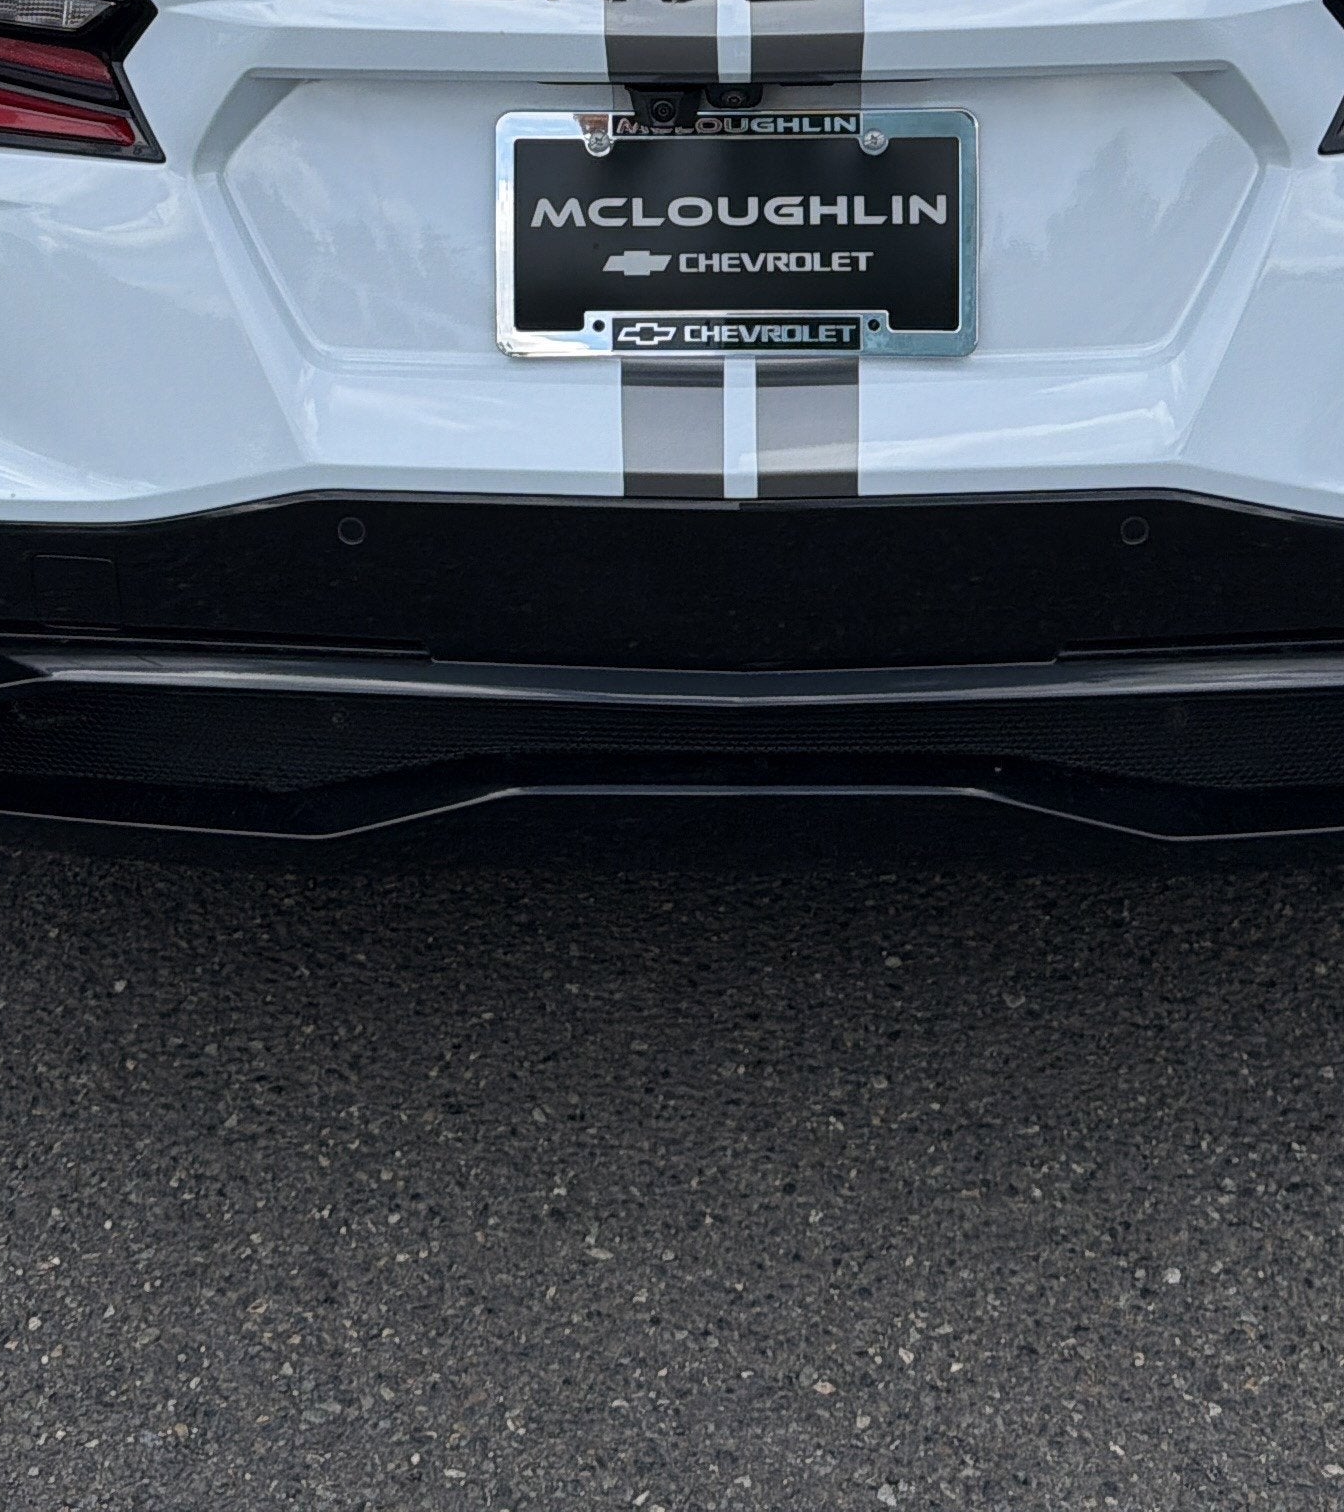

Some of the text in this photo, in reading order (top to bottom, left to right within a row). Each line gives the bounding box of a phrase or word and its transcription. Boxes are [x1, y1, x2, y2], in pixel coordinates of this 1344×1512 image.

[531, 195, 948, 228] MCLOUGHLIN
[678, 251, 874, 273] CHEVROLET
[683, 324, 857, 344] CHEVROLET
